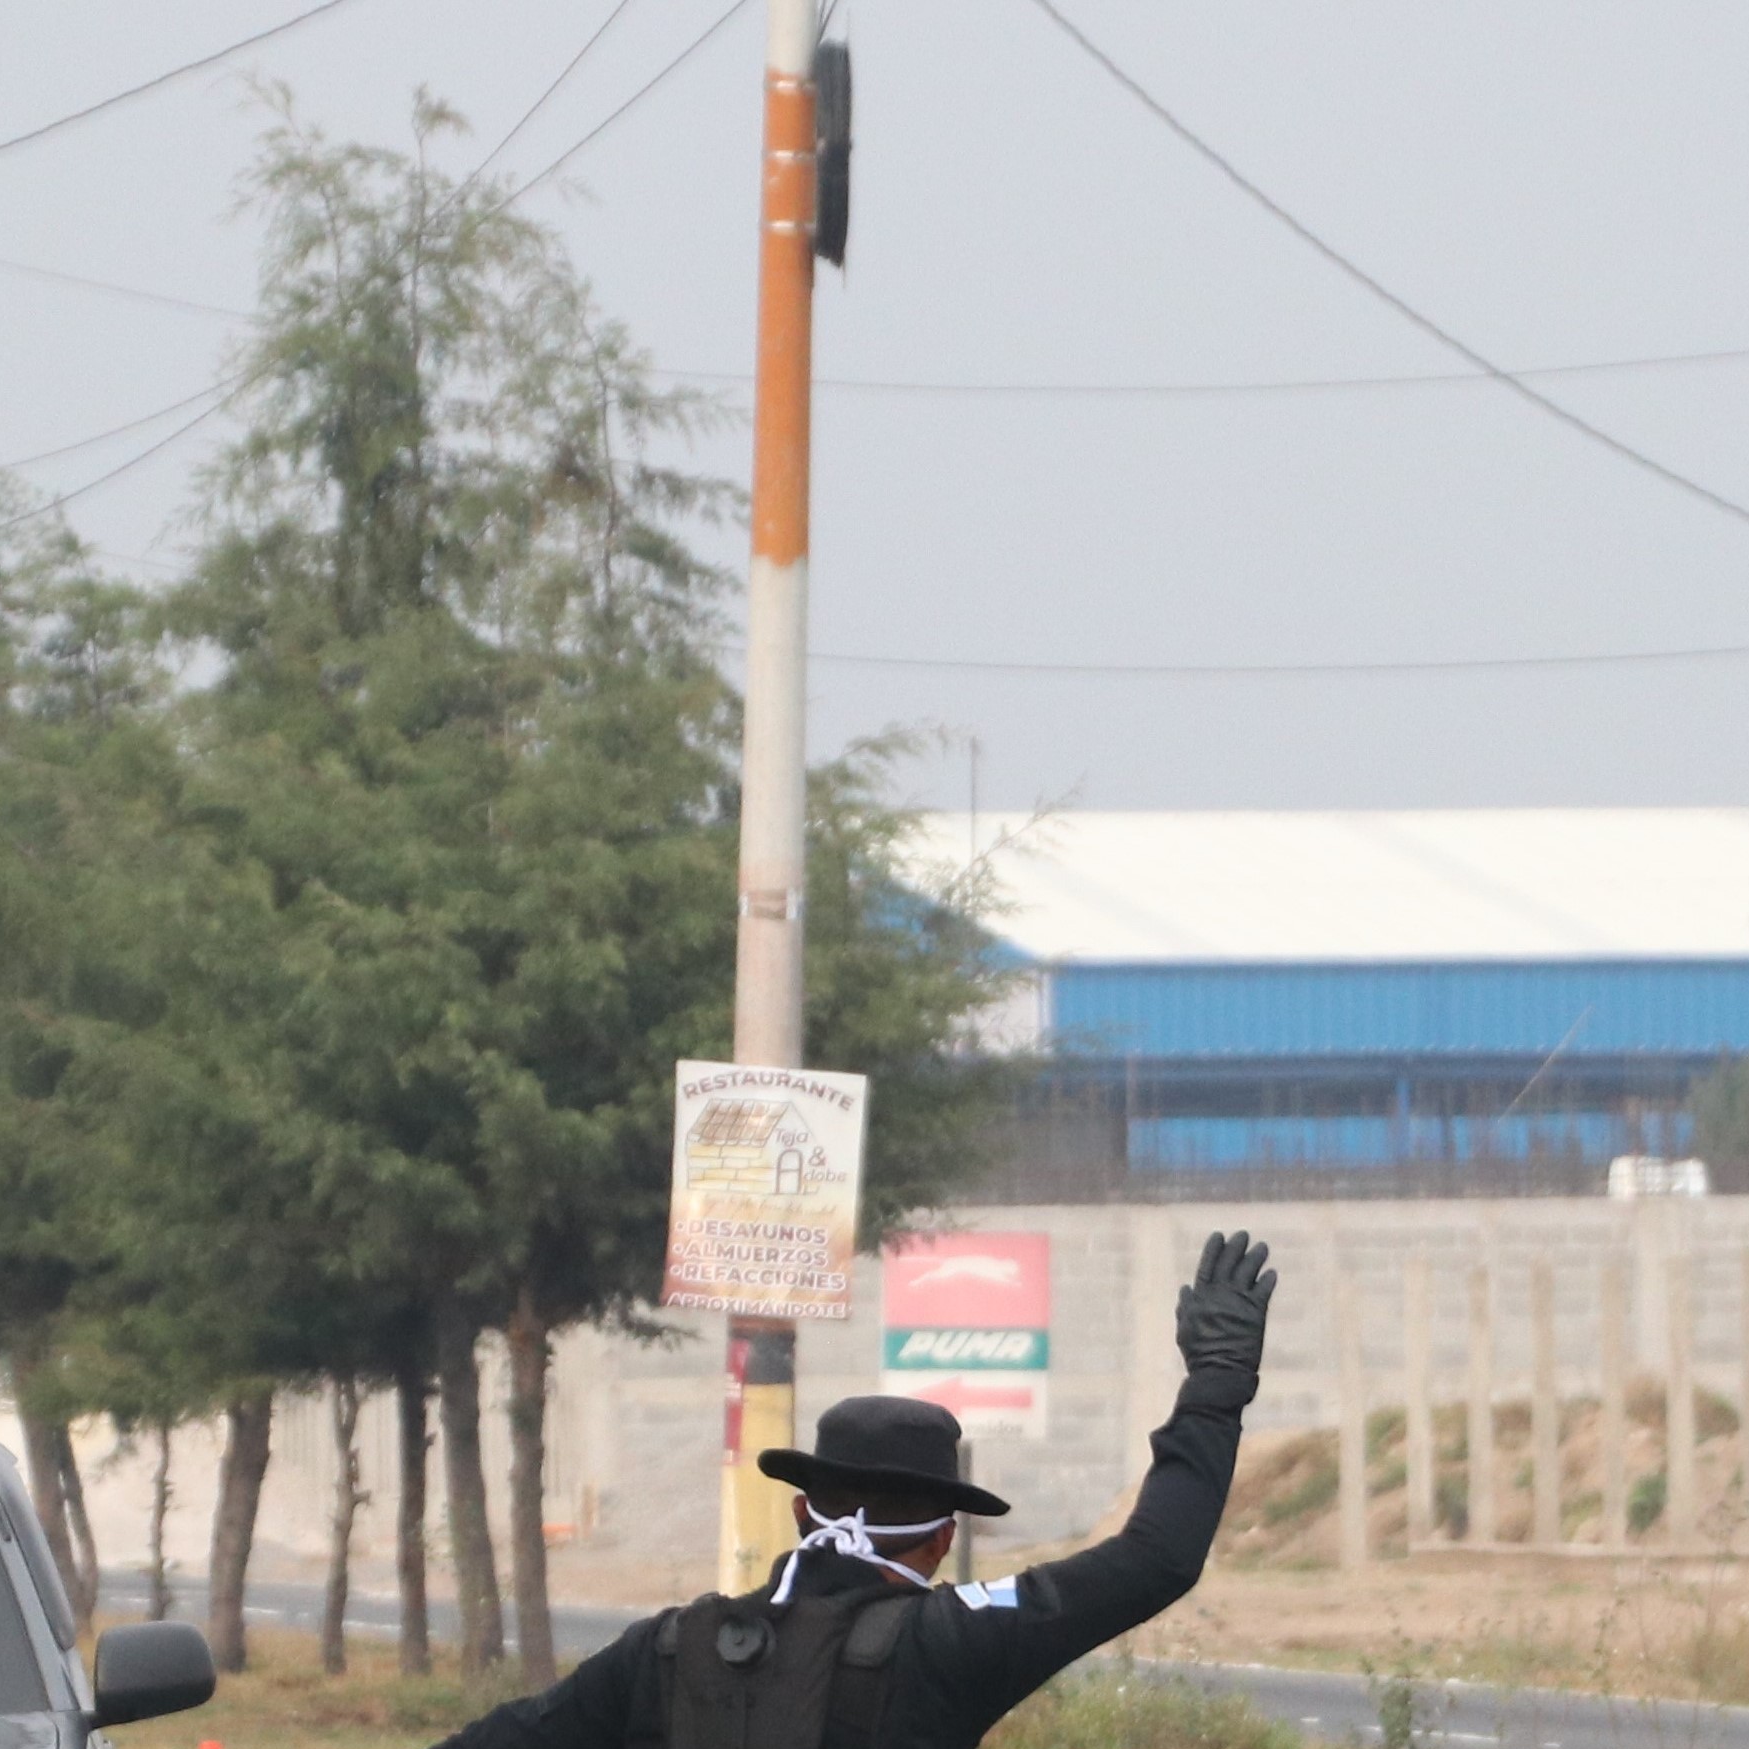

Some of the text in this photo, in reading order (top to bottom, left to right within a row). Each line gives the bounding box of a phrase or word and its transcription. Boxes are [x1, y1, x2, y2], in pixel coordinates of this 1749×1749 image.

[682, 1071, 854, 1112] RESTAURANTE
[776, 1127, 809, 1147] Teja
[808, 1146, 827, 1167] &
[688, 1219, 828, 1245] DESAYUNOS
[682, 1240, 829, 1267] ALMUERZOS
[681, 1262, 847, 1291] REFACCIONES
[897, 1331, 1034, 1361] PUMA
